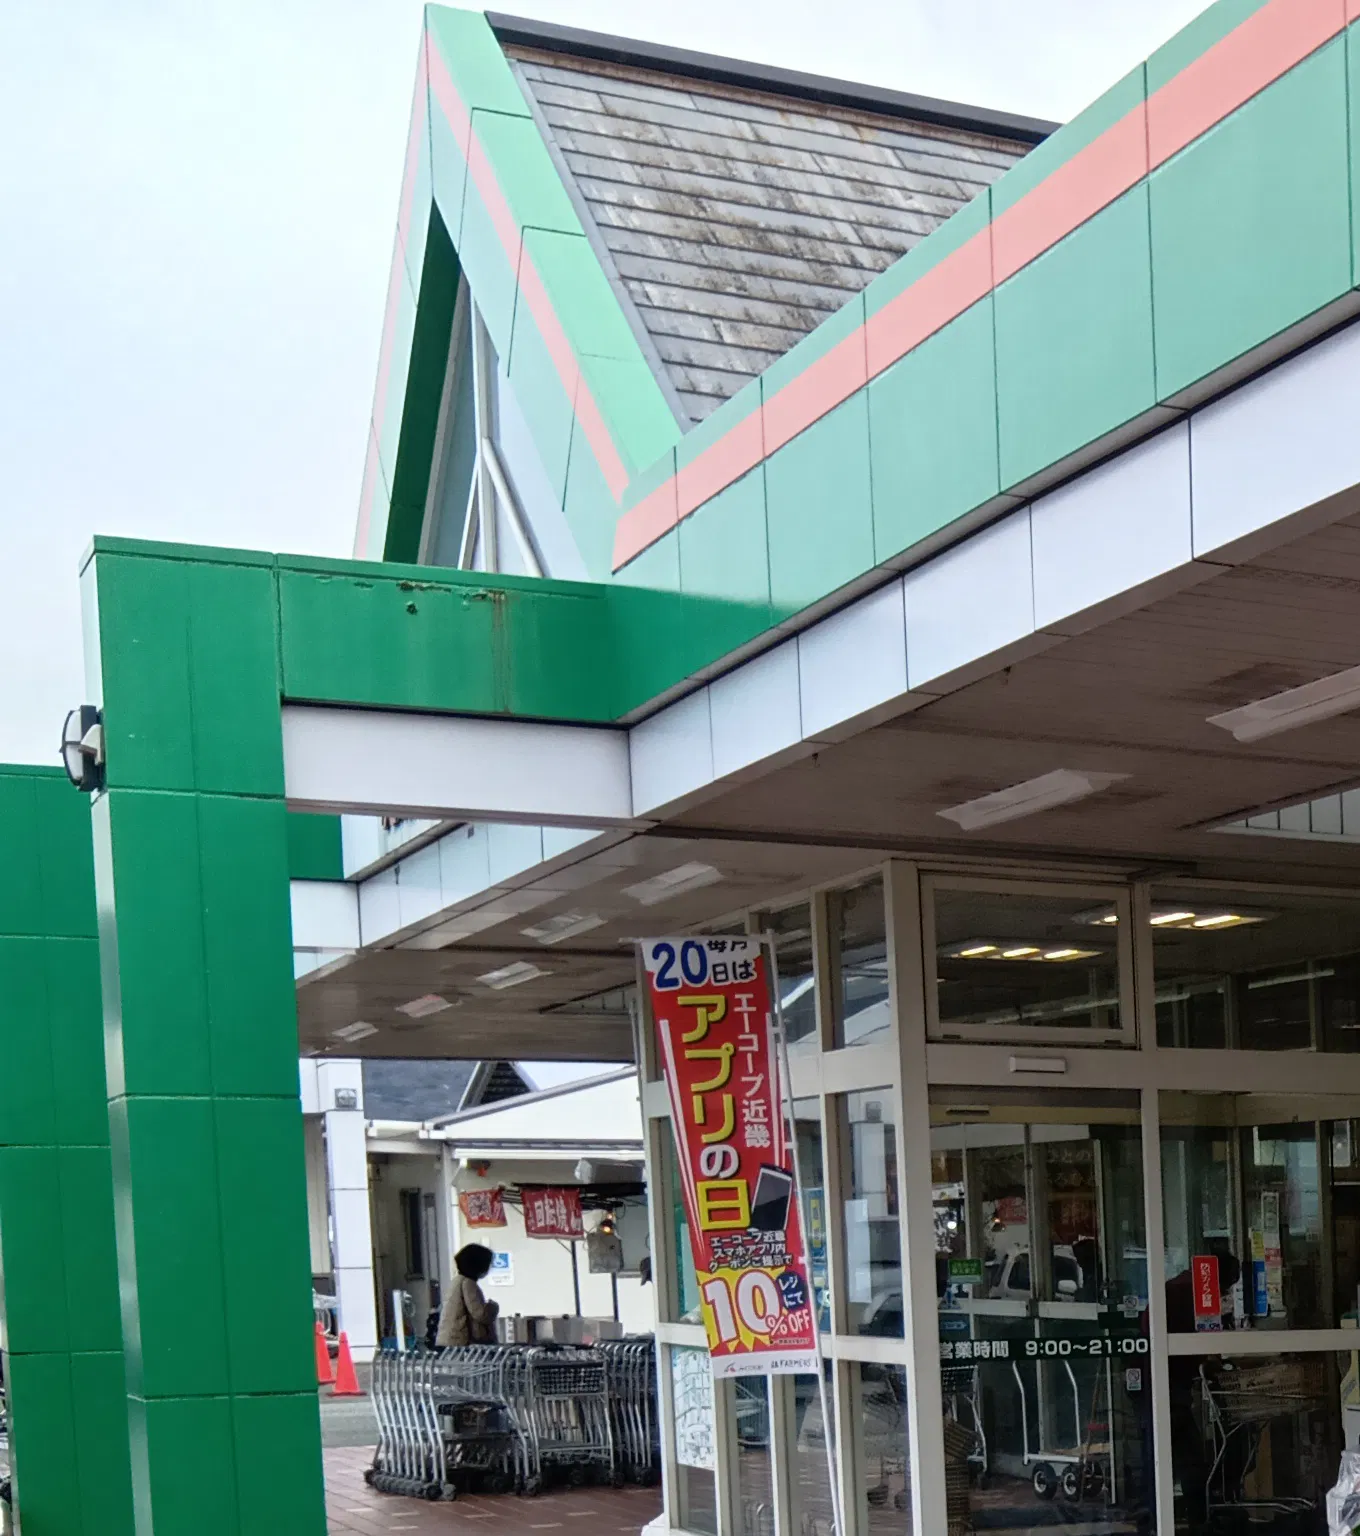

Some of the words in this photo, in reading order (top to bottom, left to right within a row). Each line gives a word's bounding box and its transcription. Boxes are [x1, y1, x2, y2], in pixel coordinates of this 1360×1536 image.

[652, 940, 707, 988] 20
[712, 961, 758, 983] 日は
[733, 993, 771, 1149] エーコープ近畿
[677, 995, 752, 1232] アプリの日
[714, 1243, 786, 1258] スマホアプリ内
[779, 1275, 798, 1290] レジ
[704, 1271, 780, 1342] 10
[783, 1291, 804, 1307] にて
[940, 1340, 1009, 1359] 営業時間
[1025, 1338, 1149, 1356] 9:00～21:00
